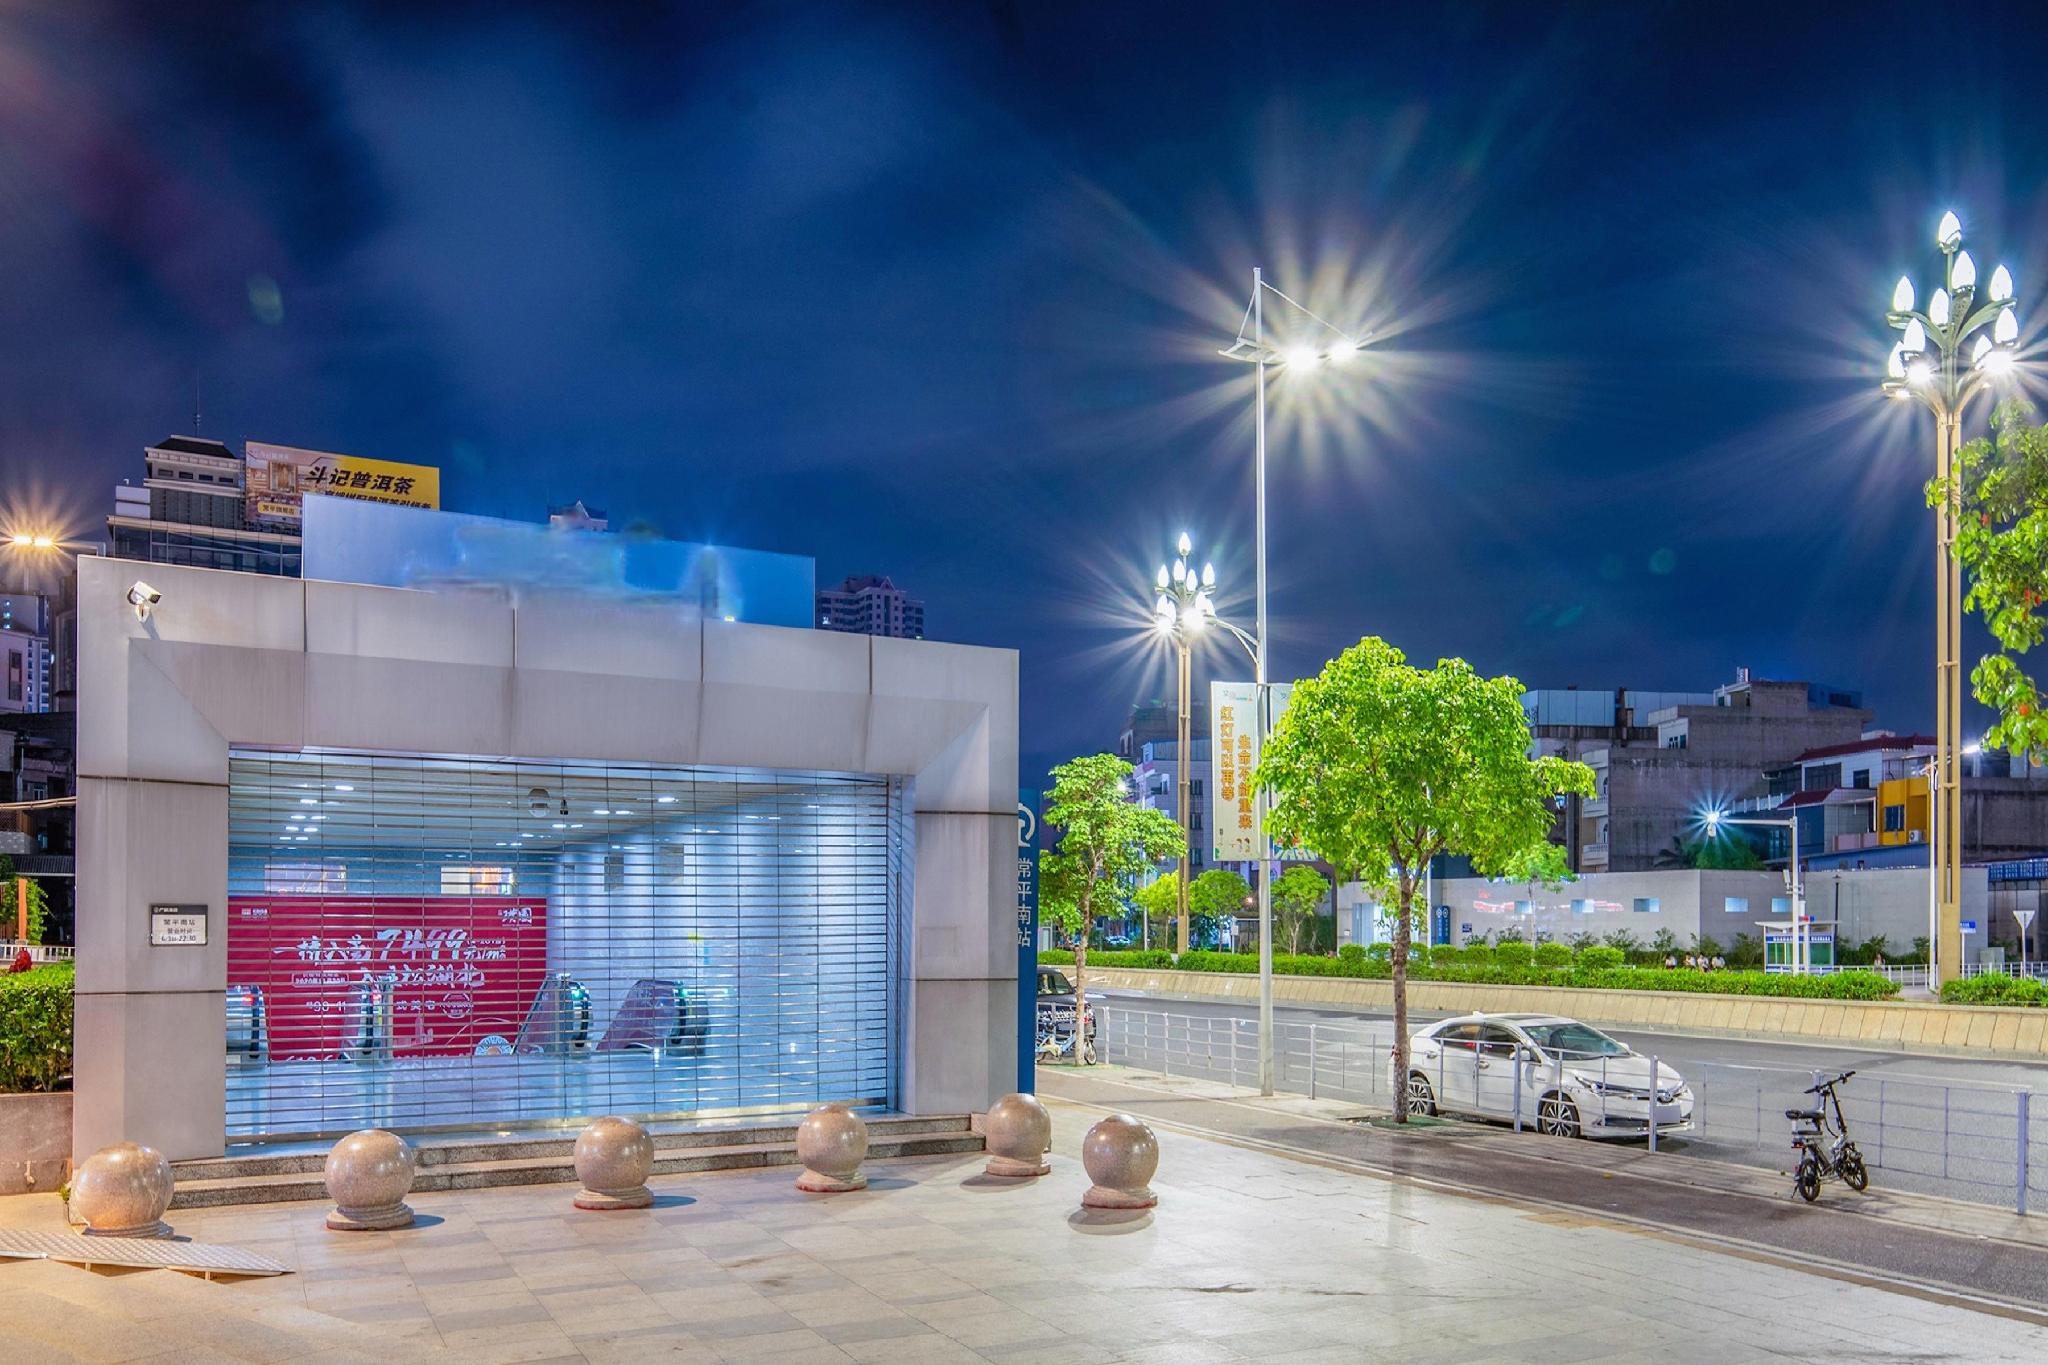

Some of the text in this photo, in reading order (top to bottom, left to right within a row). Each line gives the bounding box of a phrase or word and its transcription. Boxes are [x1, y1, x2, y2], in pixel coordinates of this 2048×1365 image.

[305, 465, 416, 496] 斗记普洱茶
[1220, 705, 1235, 802] 红灯可以再等
[1018, 857, 1033, 947] 常平南站
